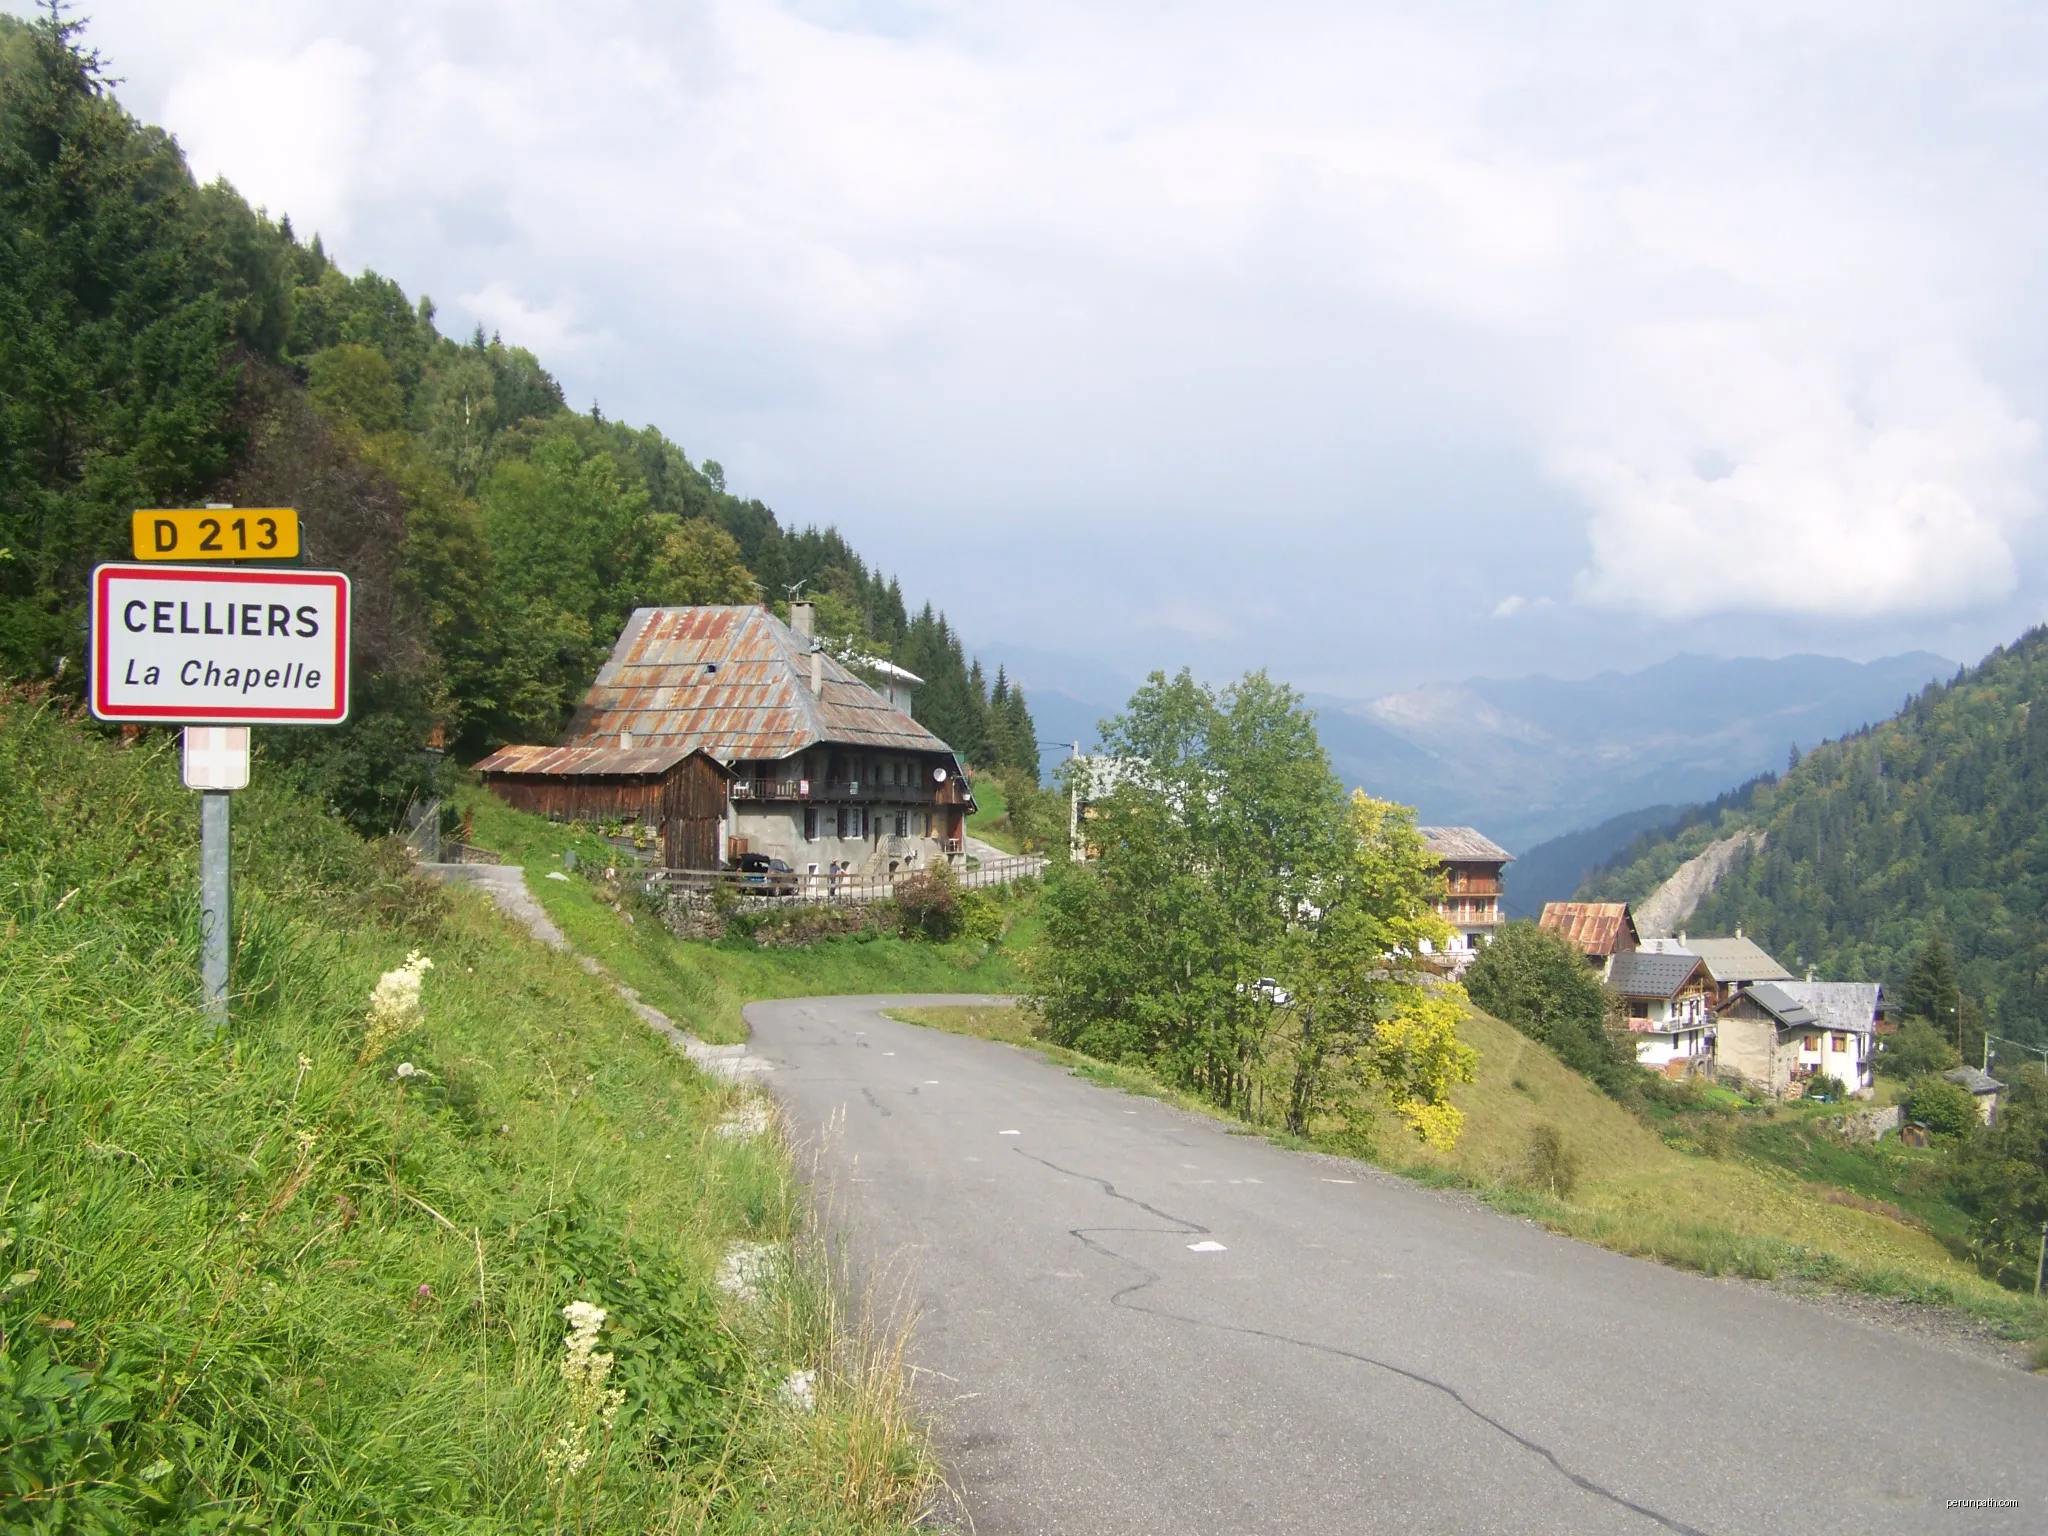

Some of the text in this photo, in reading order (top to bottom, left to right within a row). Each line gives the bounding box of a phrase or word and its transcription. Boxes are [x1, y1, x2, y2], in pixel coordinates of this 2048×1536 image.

[154, 518, 278, 552] D 213
[123, 600, 320, 638] CELLIERS
[125, 658, 322, 694] La Chapelle
